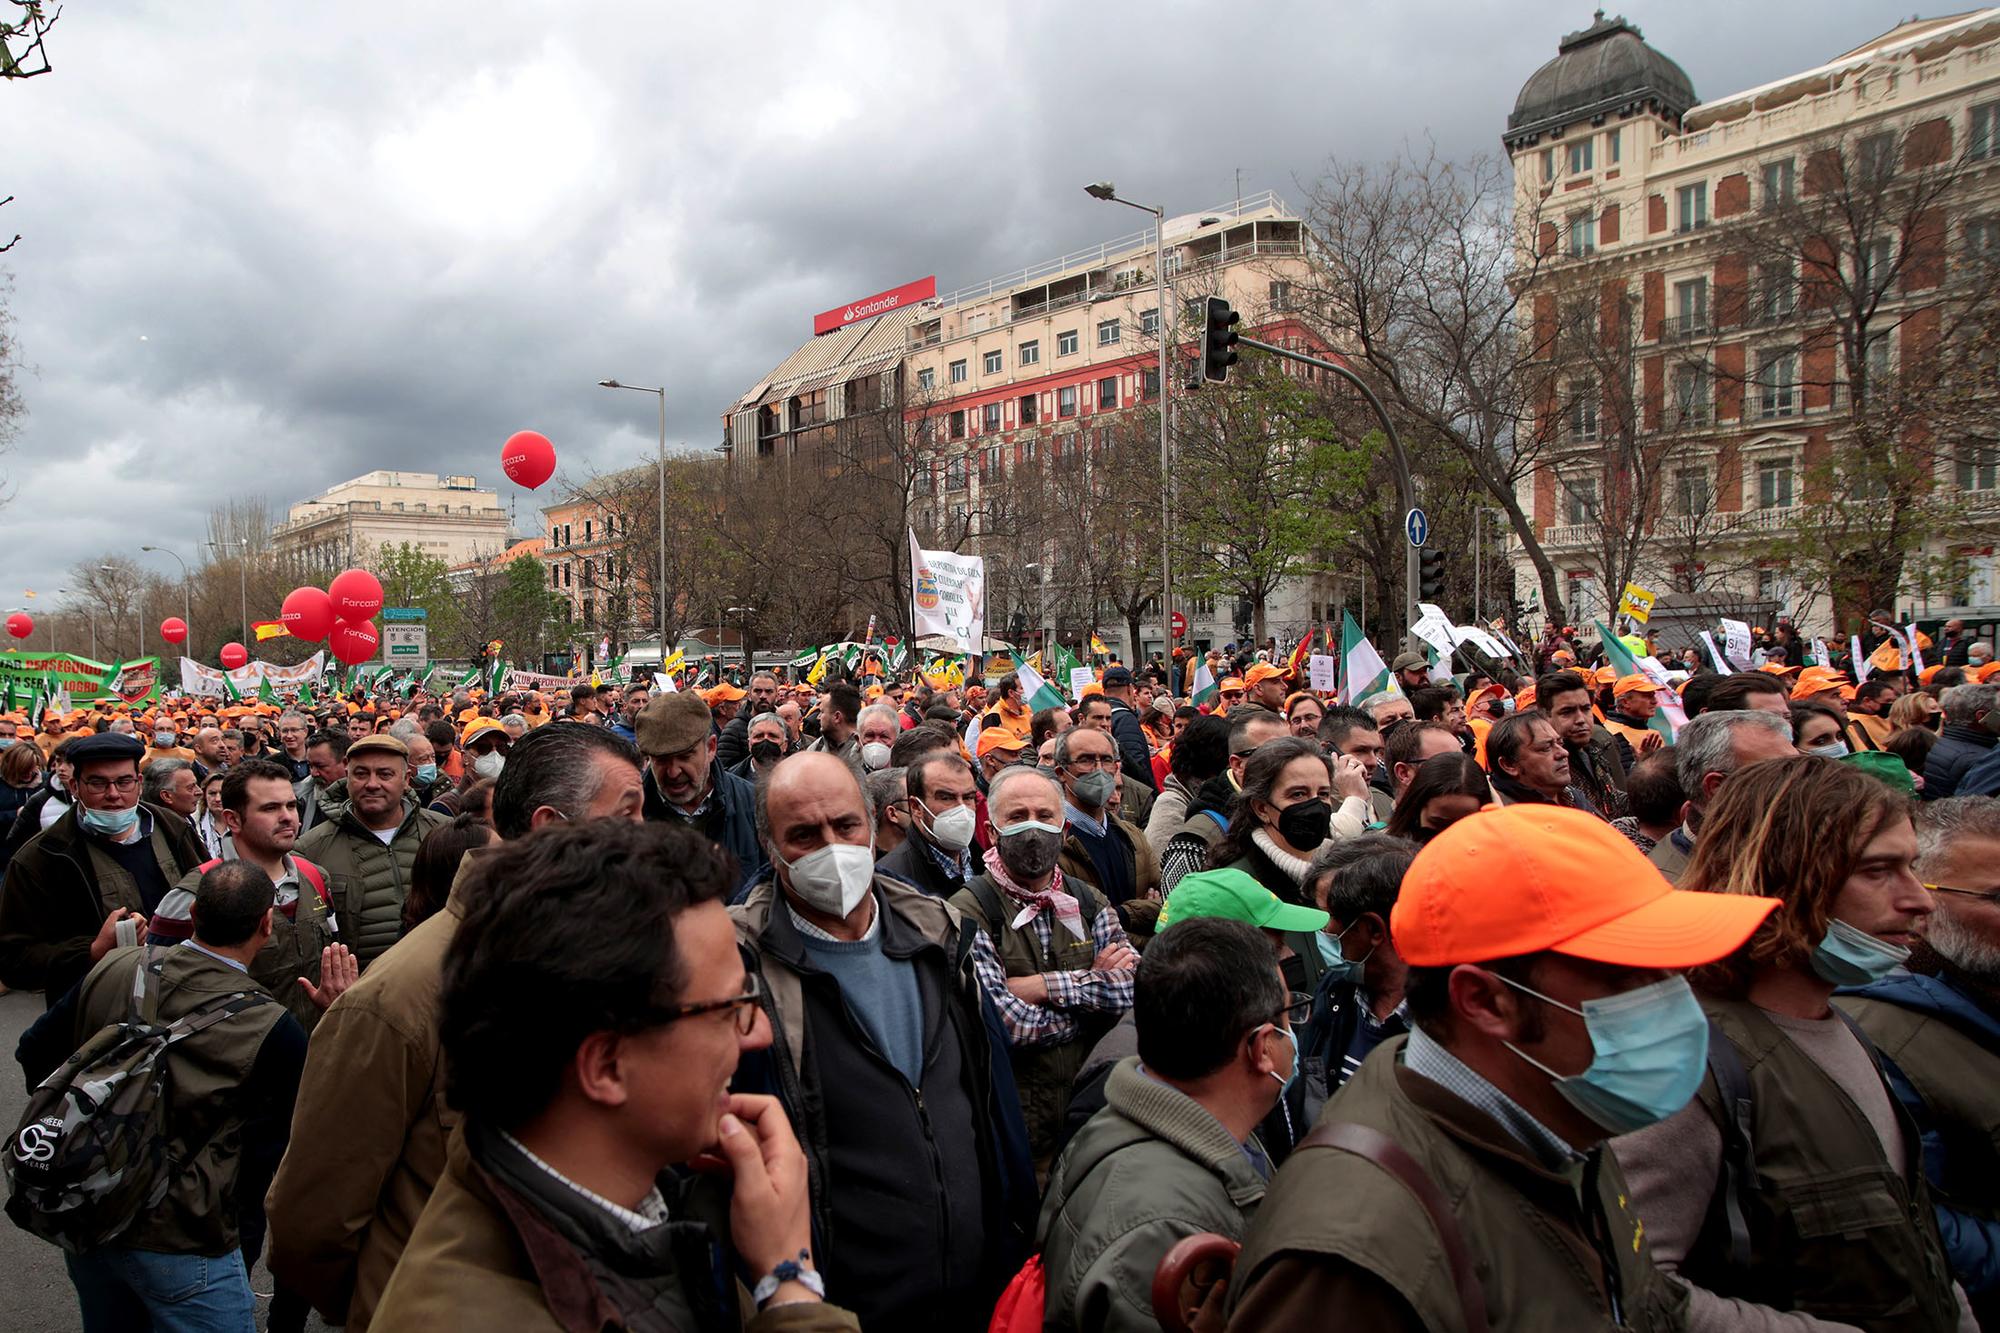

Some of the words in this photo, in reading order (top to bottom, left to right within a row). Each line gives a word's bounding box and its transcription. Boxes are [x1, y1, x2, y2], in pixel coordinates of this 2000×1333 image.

[855, 295, 899, 318] Santander
[342, 597, 379, 607] Farcaza
[343, 628, 376, 644] Farcaza
[514, 674, 531, 685] CLUB
[63, 680, 99, 693] LOGRO
